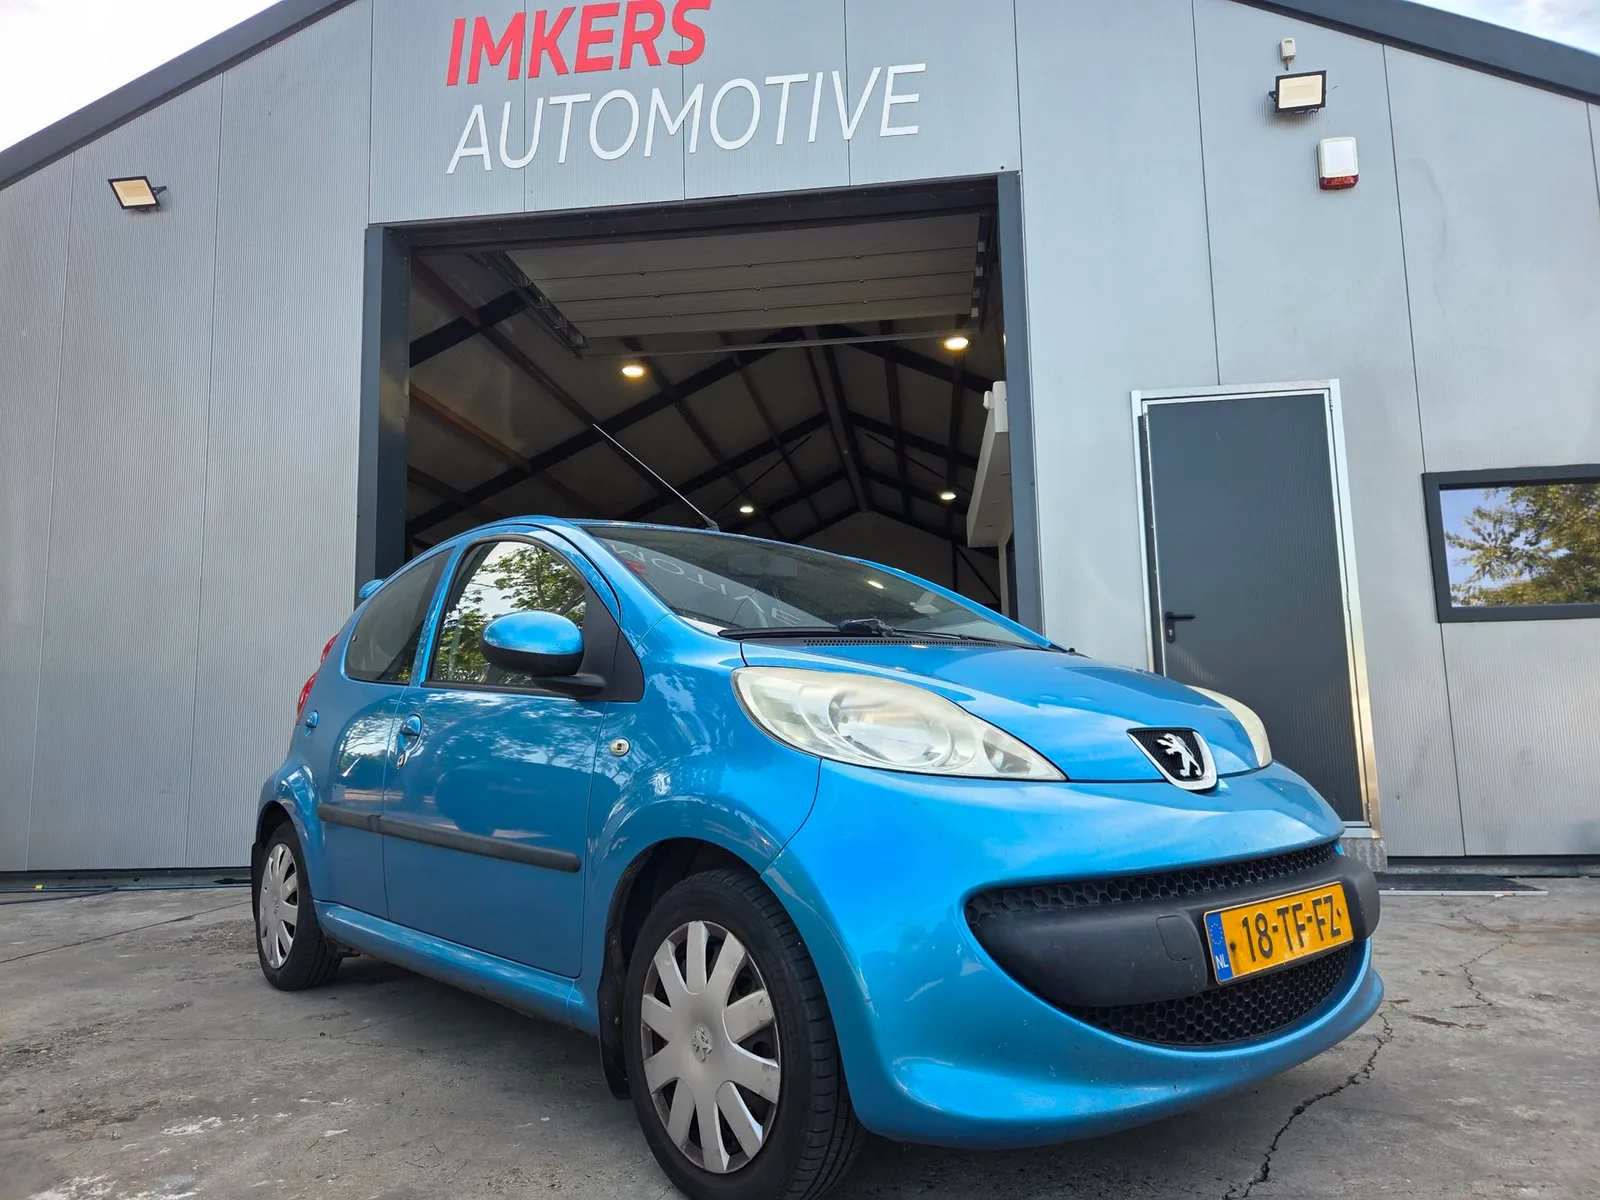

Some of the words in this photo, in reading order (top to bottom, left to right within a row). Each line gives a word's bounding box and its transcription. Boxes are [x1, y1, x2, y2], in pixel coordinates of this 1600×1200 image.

[446, 0, 712, 87] IMKERS
[446, 63, 927, 174] AUTOMOTIVE
[1215, 955, 1229, 970] NL
[1241, 893, 1342, 962] 18-TF-FZ
